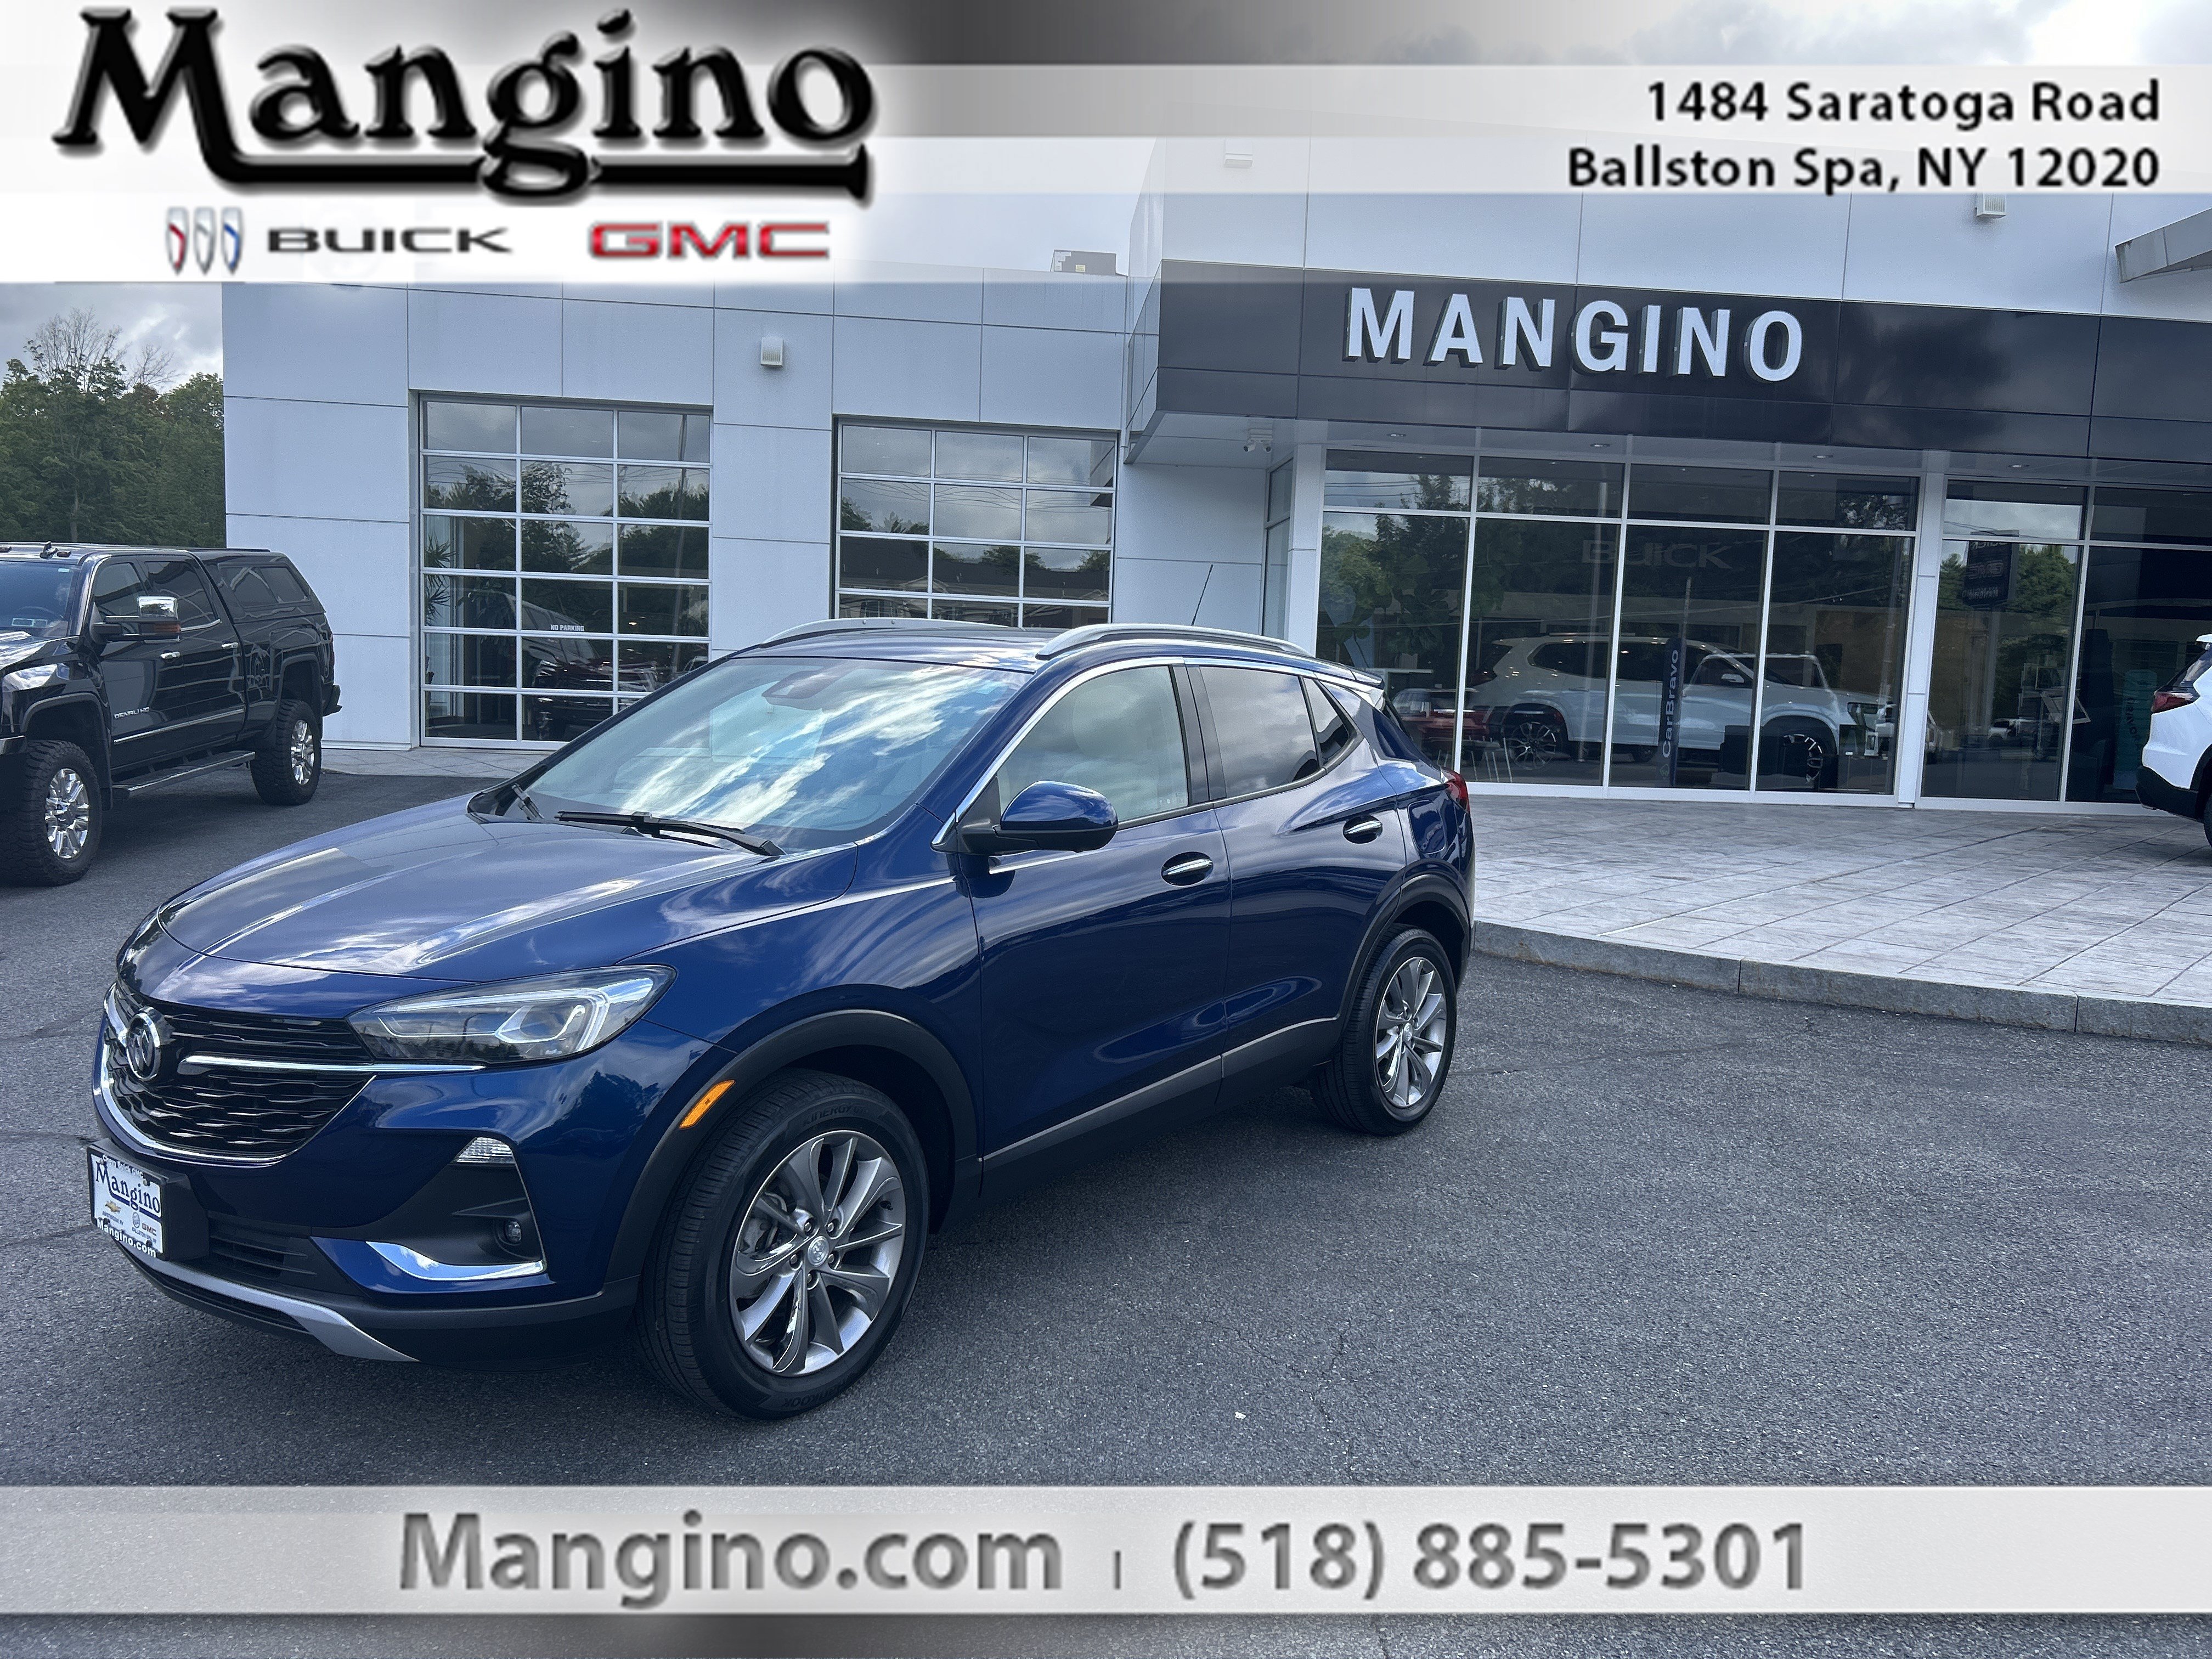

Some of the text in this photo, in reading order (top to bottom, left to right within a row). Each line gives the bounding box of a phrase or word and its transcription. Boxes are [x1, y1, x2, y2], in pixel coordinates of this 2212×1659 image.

[1345, 287, 1803, 382] MANGINO
[1662, 650, 1678, 758] CarBravo
[95, 1160, 161, 1219] Mangino
[97, 1217, 156, 1258] Mangino.com
